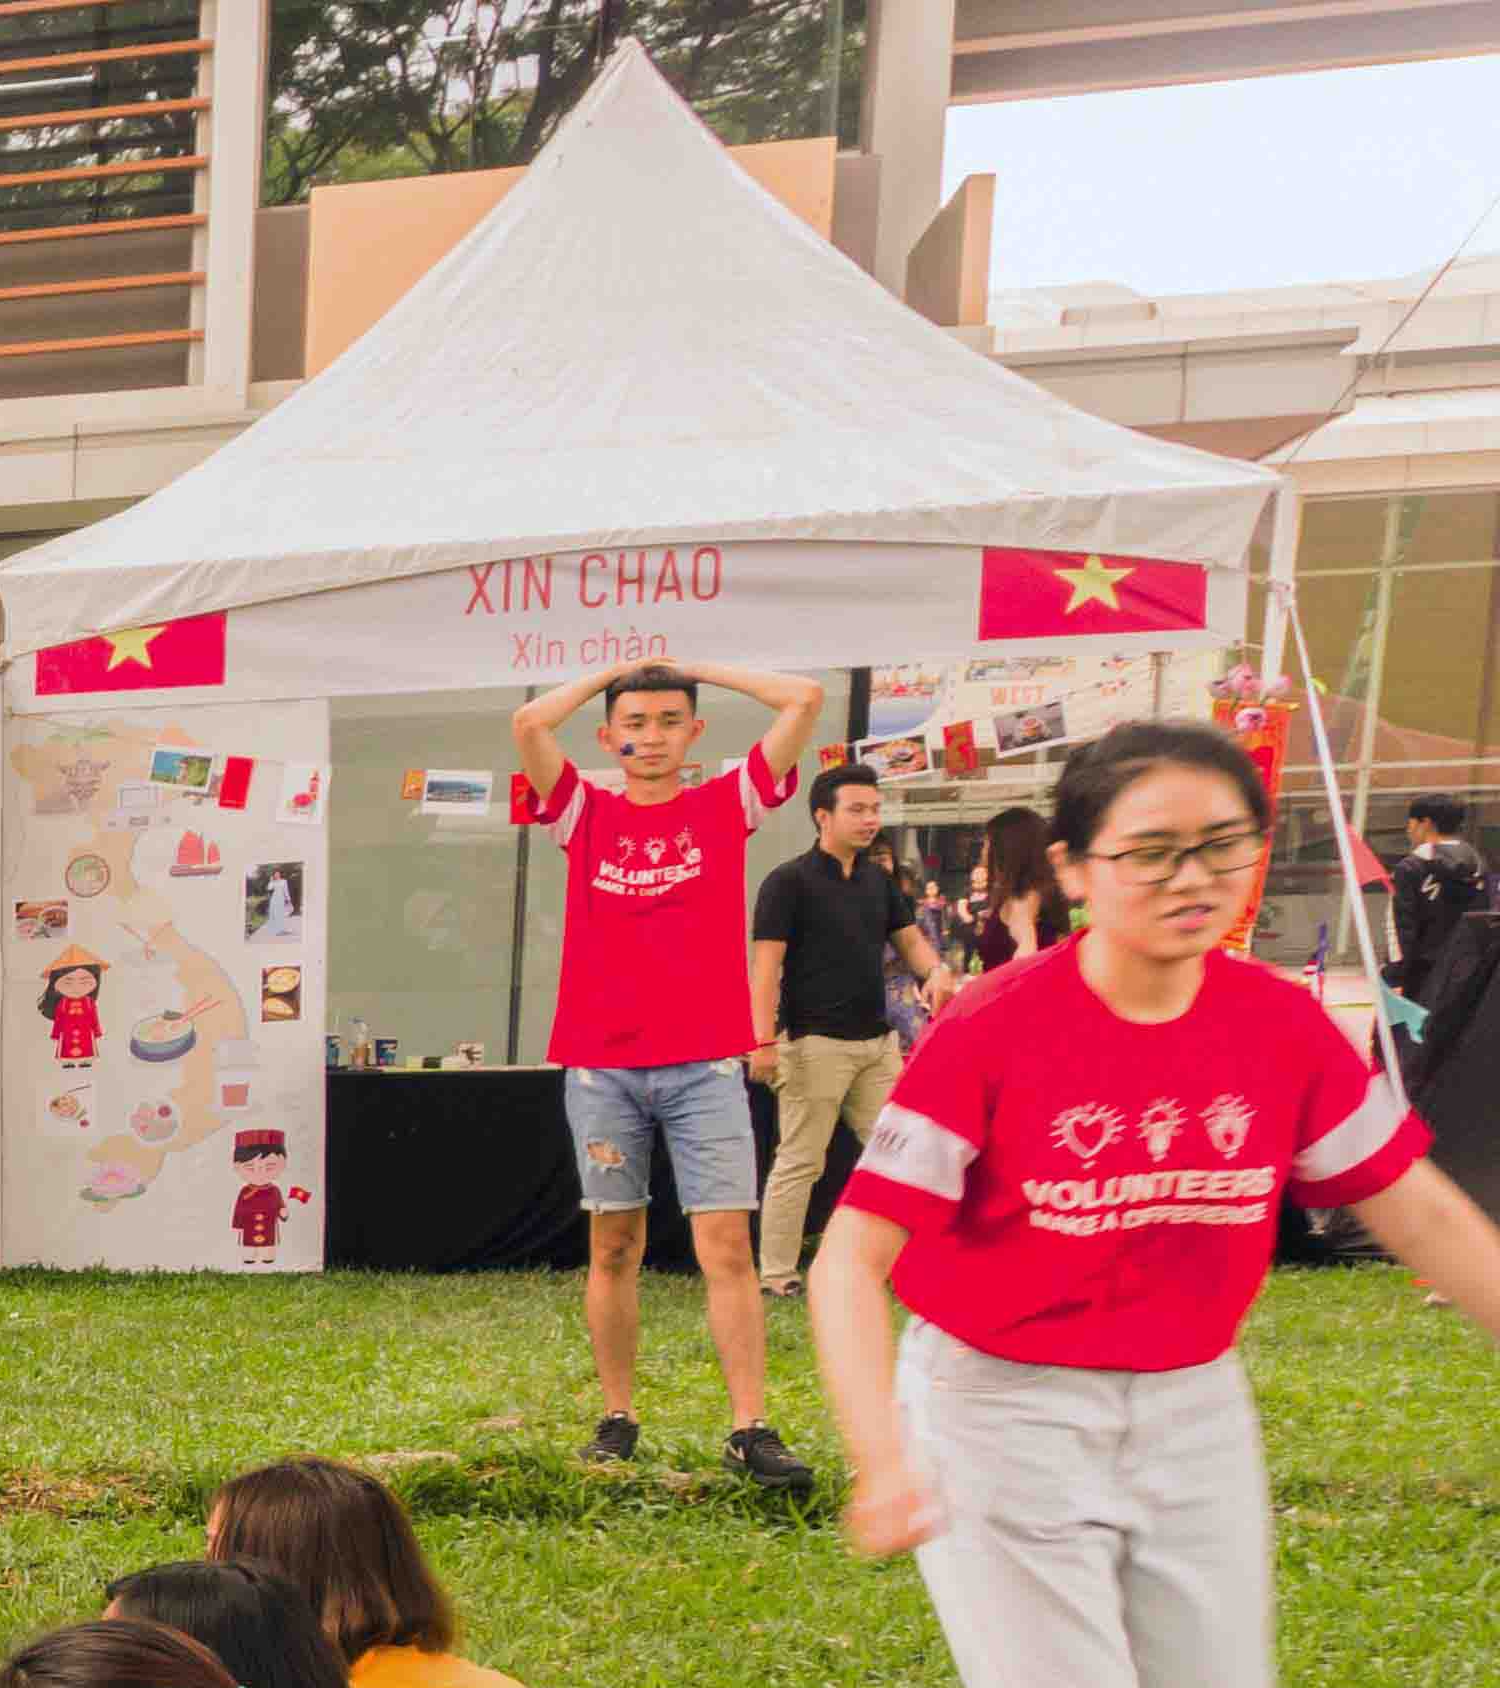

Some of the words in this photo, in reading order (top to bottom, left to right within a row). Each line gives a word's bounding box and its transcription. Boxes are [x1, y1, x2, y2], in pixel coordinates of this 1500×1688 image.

[464, 557, 553, 616] XIN
[579, 544, 723, 609] CHAO
[510, 631, 566, 670] Xin
[1021, 1166, 1276, 1211] VOLUNTEERS
[1029, 1210, 1101, 1237] MAKE
[1101, 1212, 1118, 1233] A
[1122, 1201, 1269, 1230] DIFFERENCE
